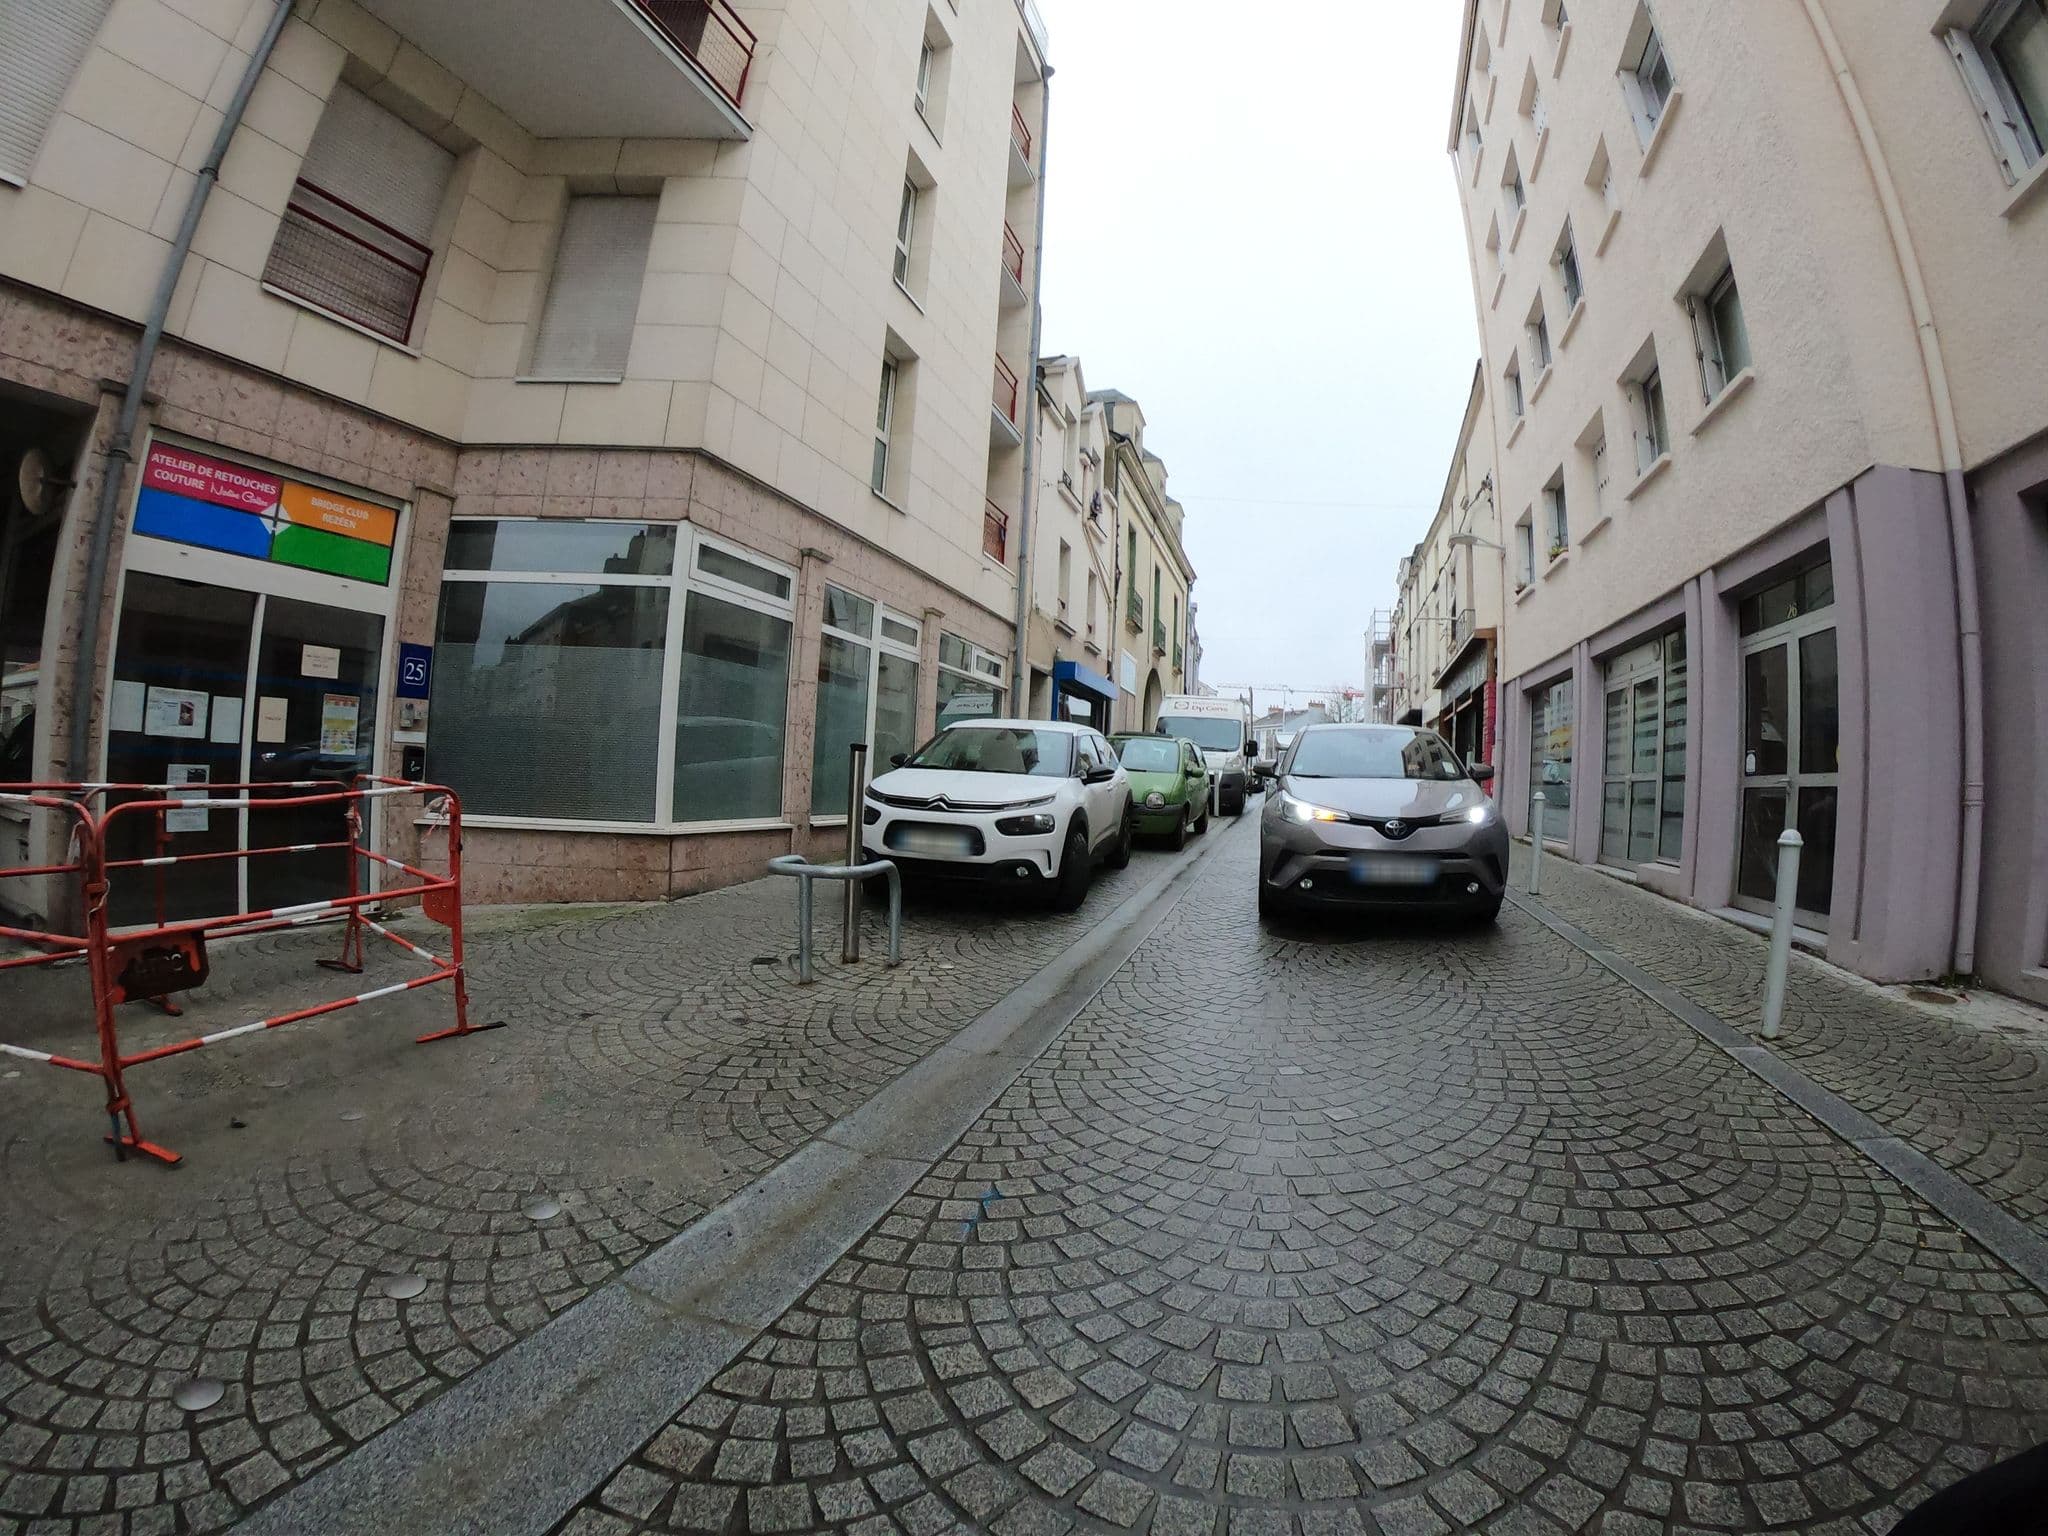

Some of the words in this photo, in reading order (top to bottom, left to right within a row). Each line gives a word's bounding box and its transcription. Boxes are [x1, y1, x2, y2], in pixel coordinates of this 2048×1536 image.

[151, 453, 196, 473] ATELIER
[197, 465, 213, 478] DE
[214, 469, 277, 495] RETOUCHES
[154, 468, 205, 490] COUTURE
[311, 497, 345, 514] BRIDGE
[346, 507, 369, 520] CLUB
[1786, 602, 1798, 619] 26
[405, 662, 425, 681] 25
